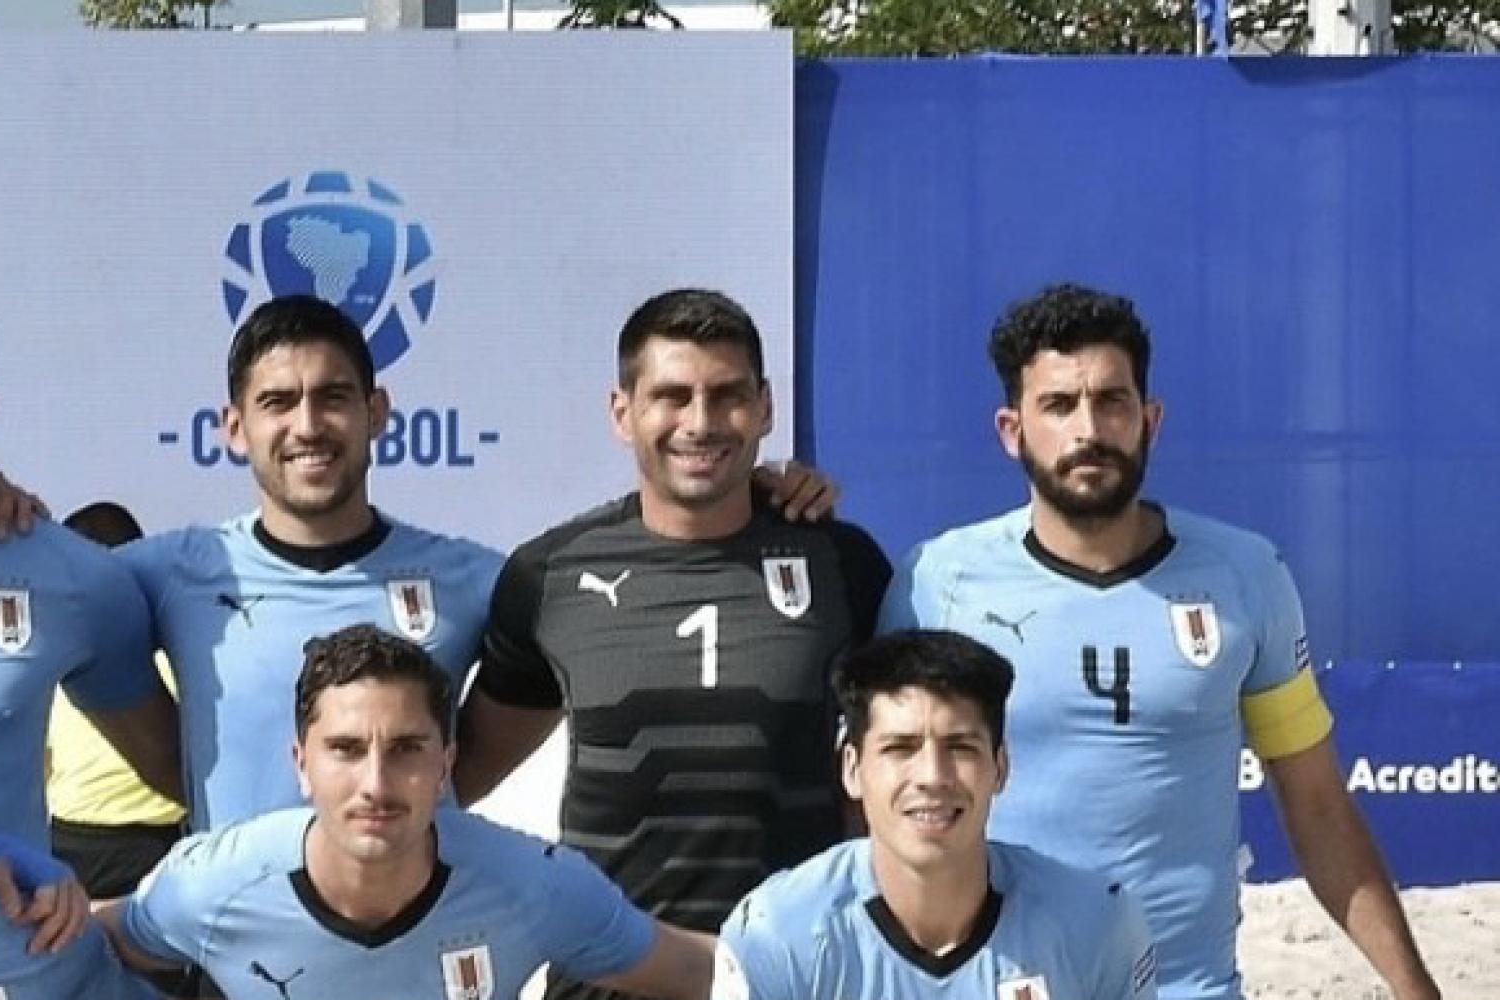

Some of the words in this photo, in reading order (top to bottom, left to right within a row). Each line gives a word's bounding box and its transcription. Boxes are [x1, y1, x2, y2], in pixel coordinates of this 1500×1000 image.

[675, 604, 719, 688] 1
[1081, 645, 1133, 724] 4
[1346, 754, 1500, 793] Acredit
